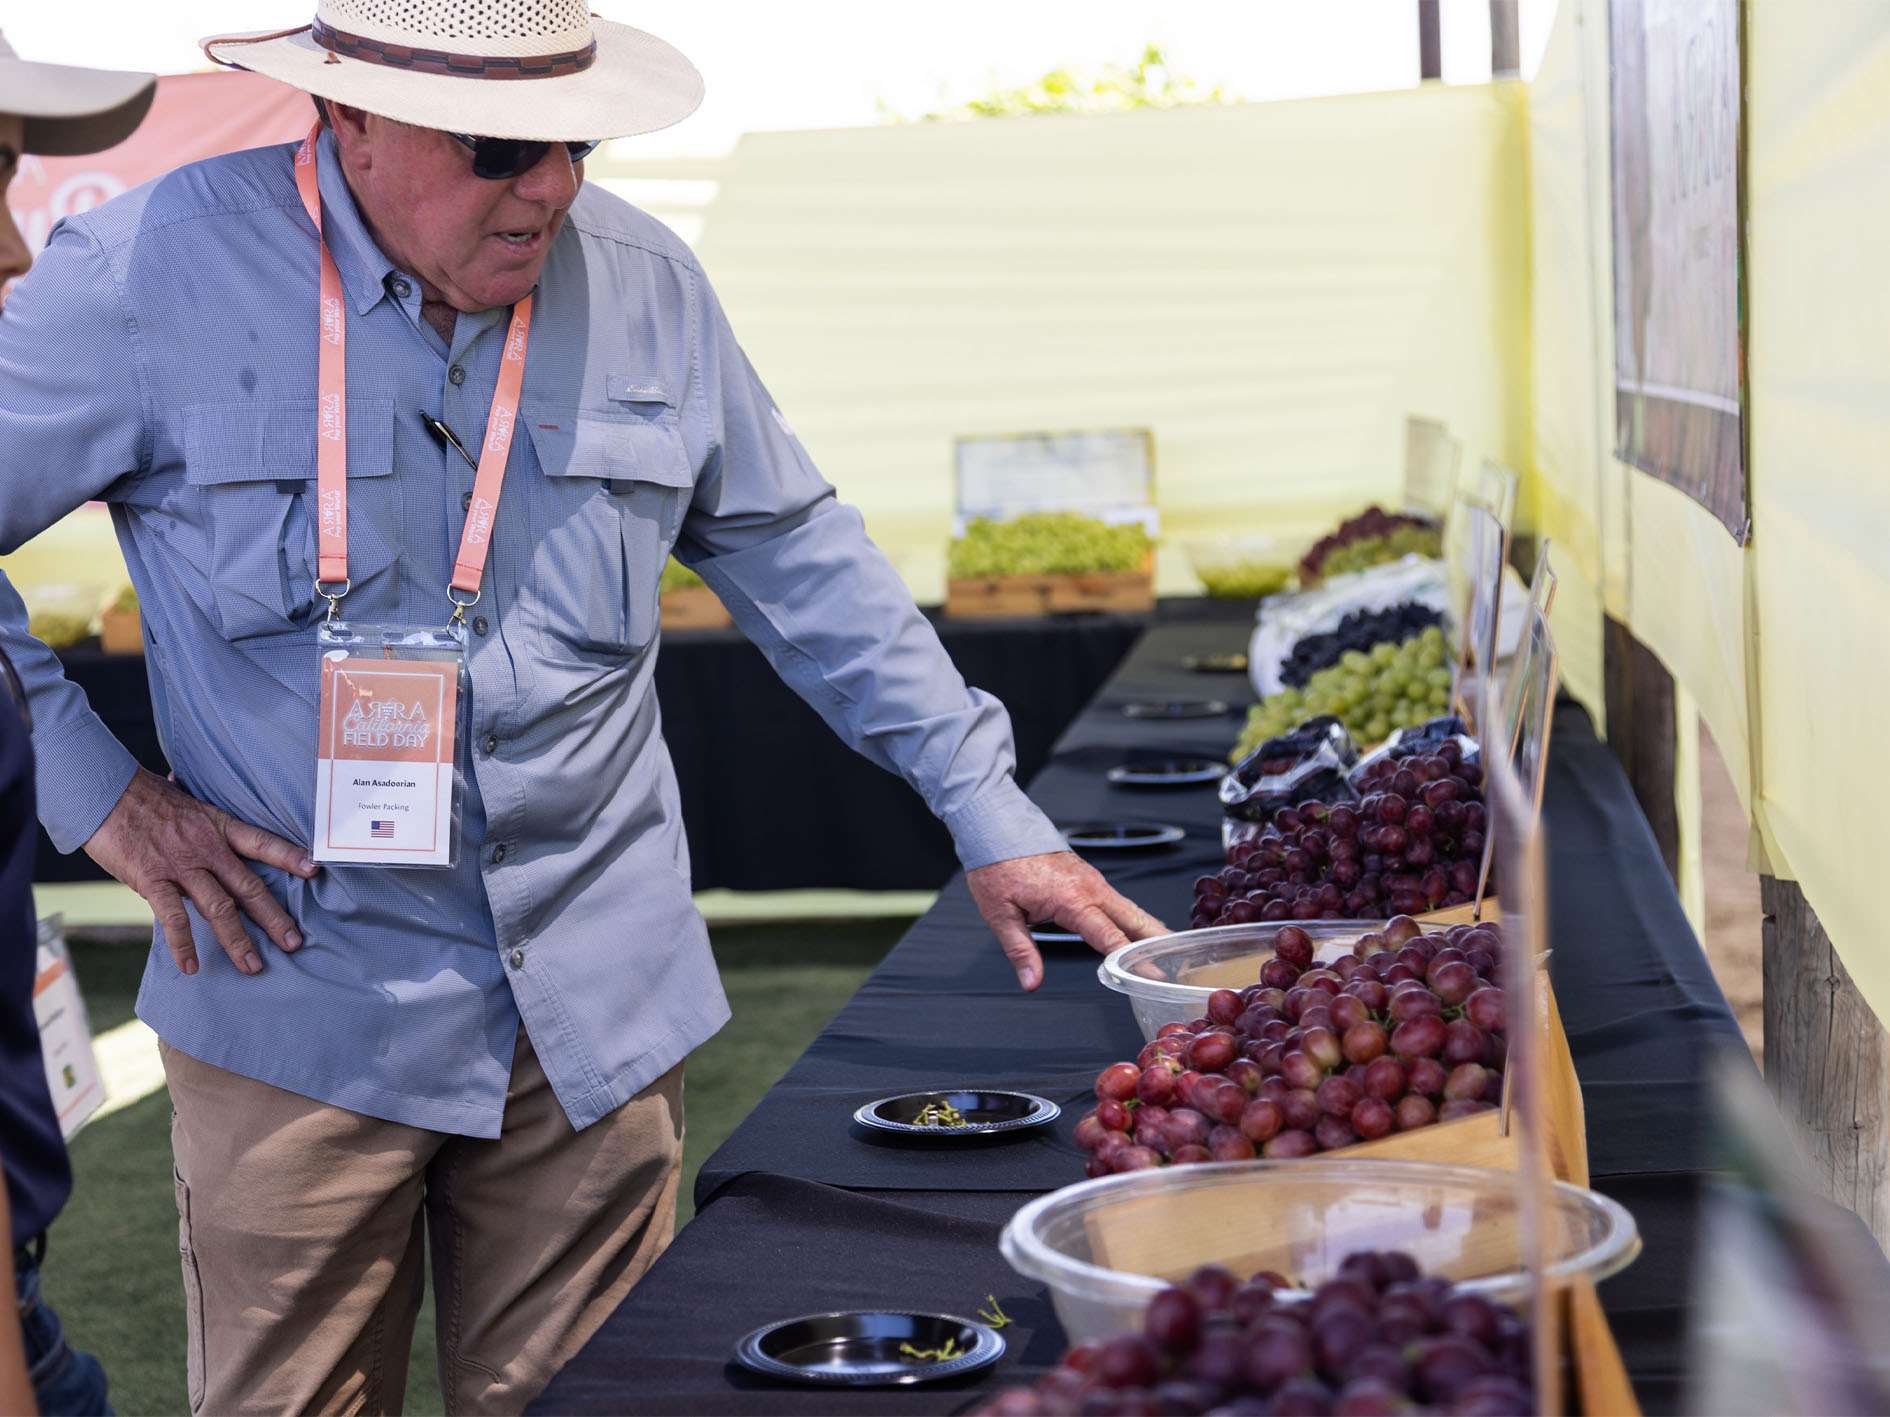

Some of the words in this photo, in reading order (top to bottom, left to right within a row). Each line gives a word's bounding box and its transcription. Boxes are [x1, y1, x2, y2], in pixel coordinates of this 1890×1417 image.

[343, 731, 389, 748] FIELD
[392, 732, 429, 749] DAY
[352, 778, 371, 787] Alan
[371, 779, 416, 788] Asadoorian
[358, 802, 381, 811] Fowler
[383, 803, 410, 812] Packing
